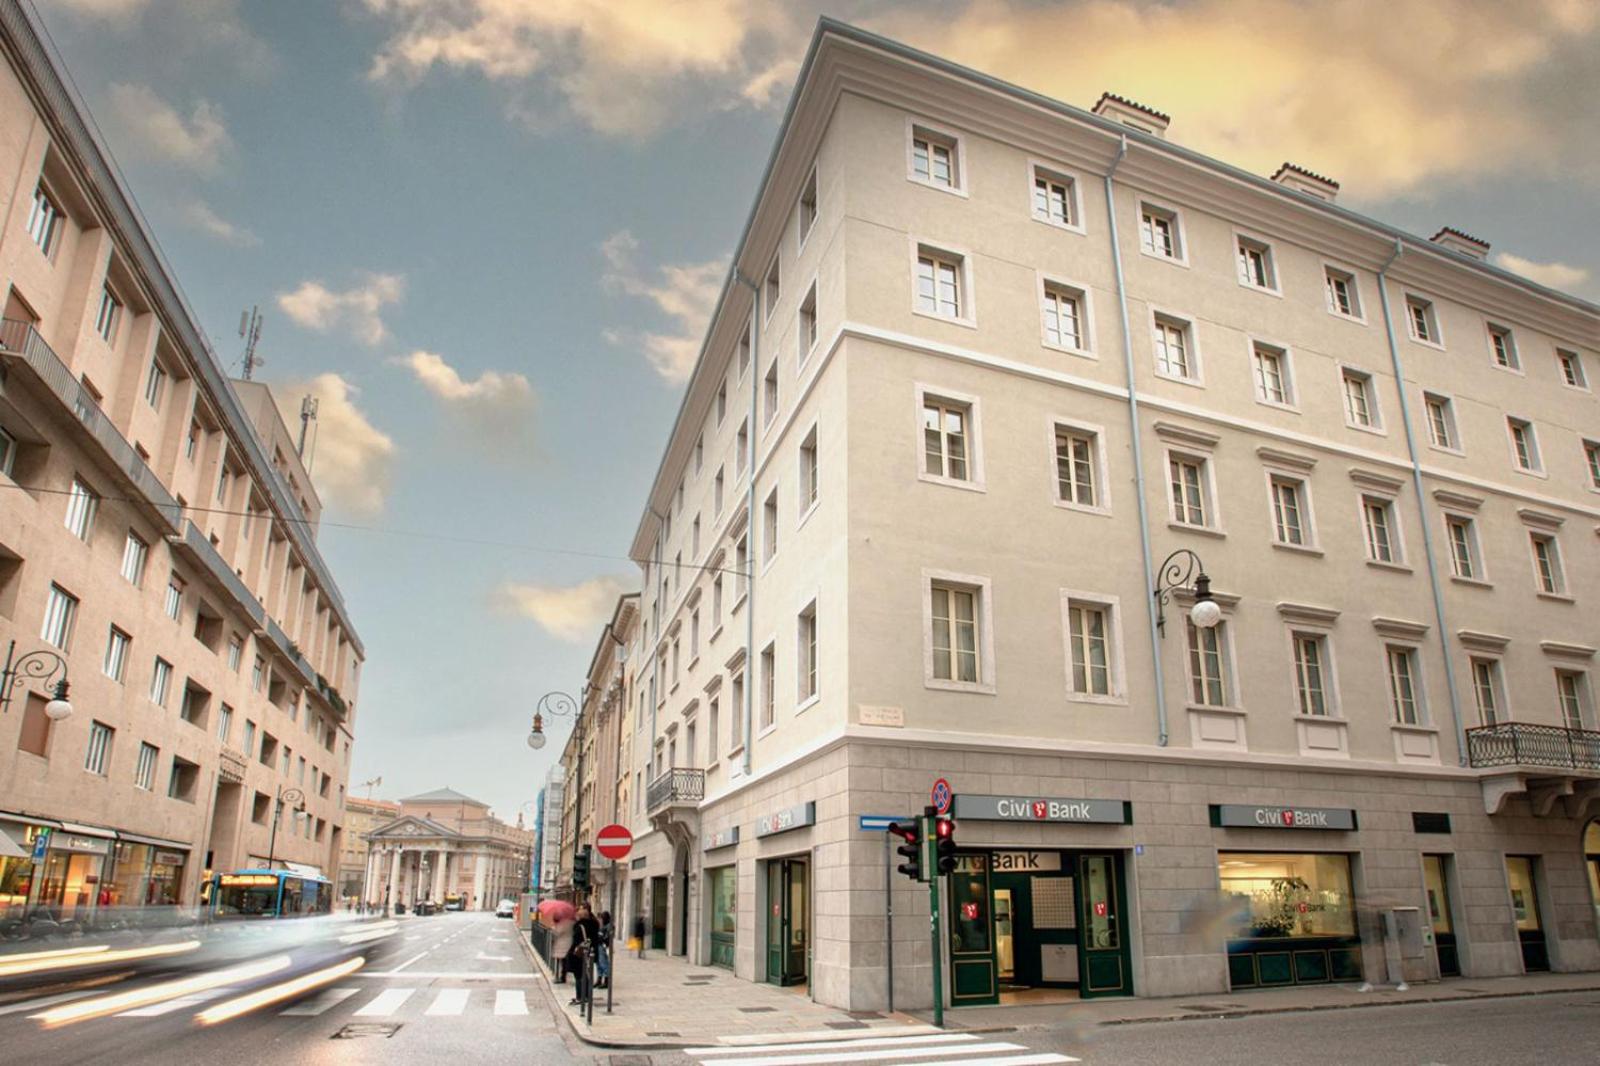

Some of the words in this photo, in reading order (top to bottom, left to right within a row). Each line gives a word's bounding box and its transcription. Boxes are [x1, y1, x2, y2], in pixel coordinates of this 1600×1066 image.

[997, 800, 1030, 817] Civi
[1049, 802, 1090, 819] Bank
[1255, 809, 1281, 824] Civi
[1295, 811, 1327, 825] Bank
[36, 837, 45, 854] P
[993, 852, 1040, 870] Bank
